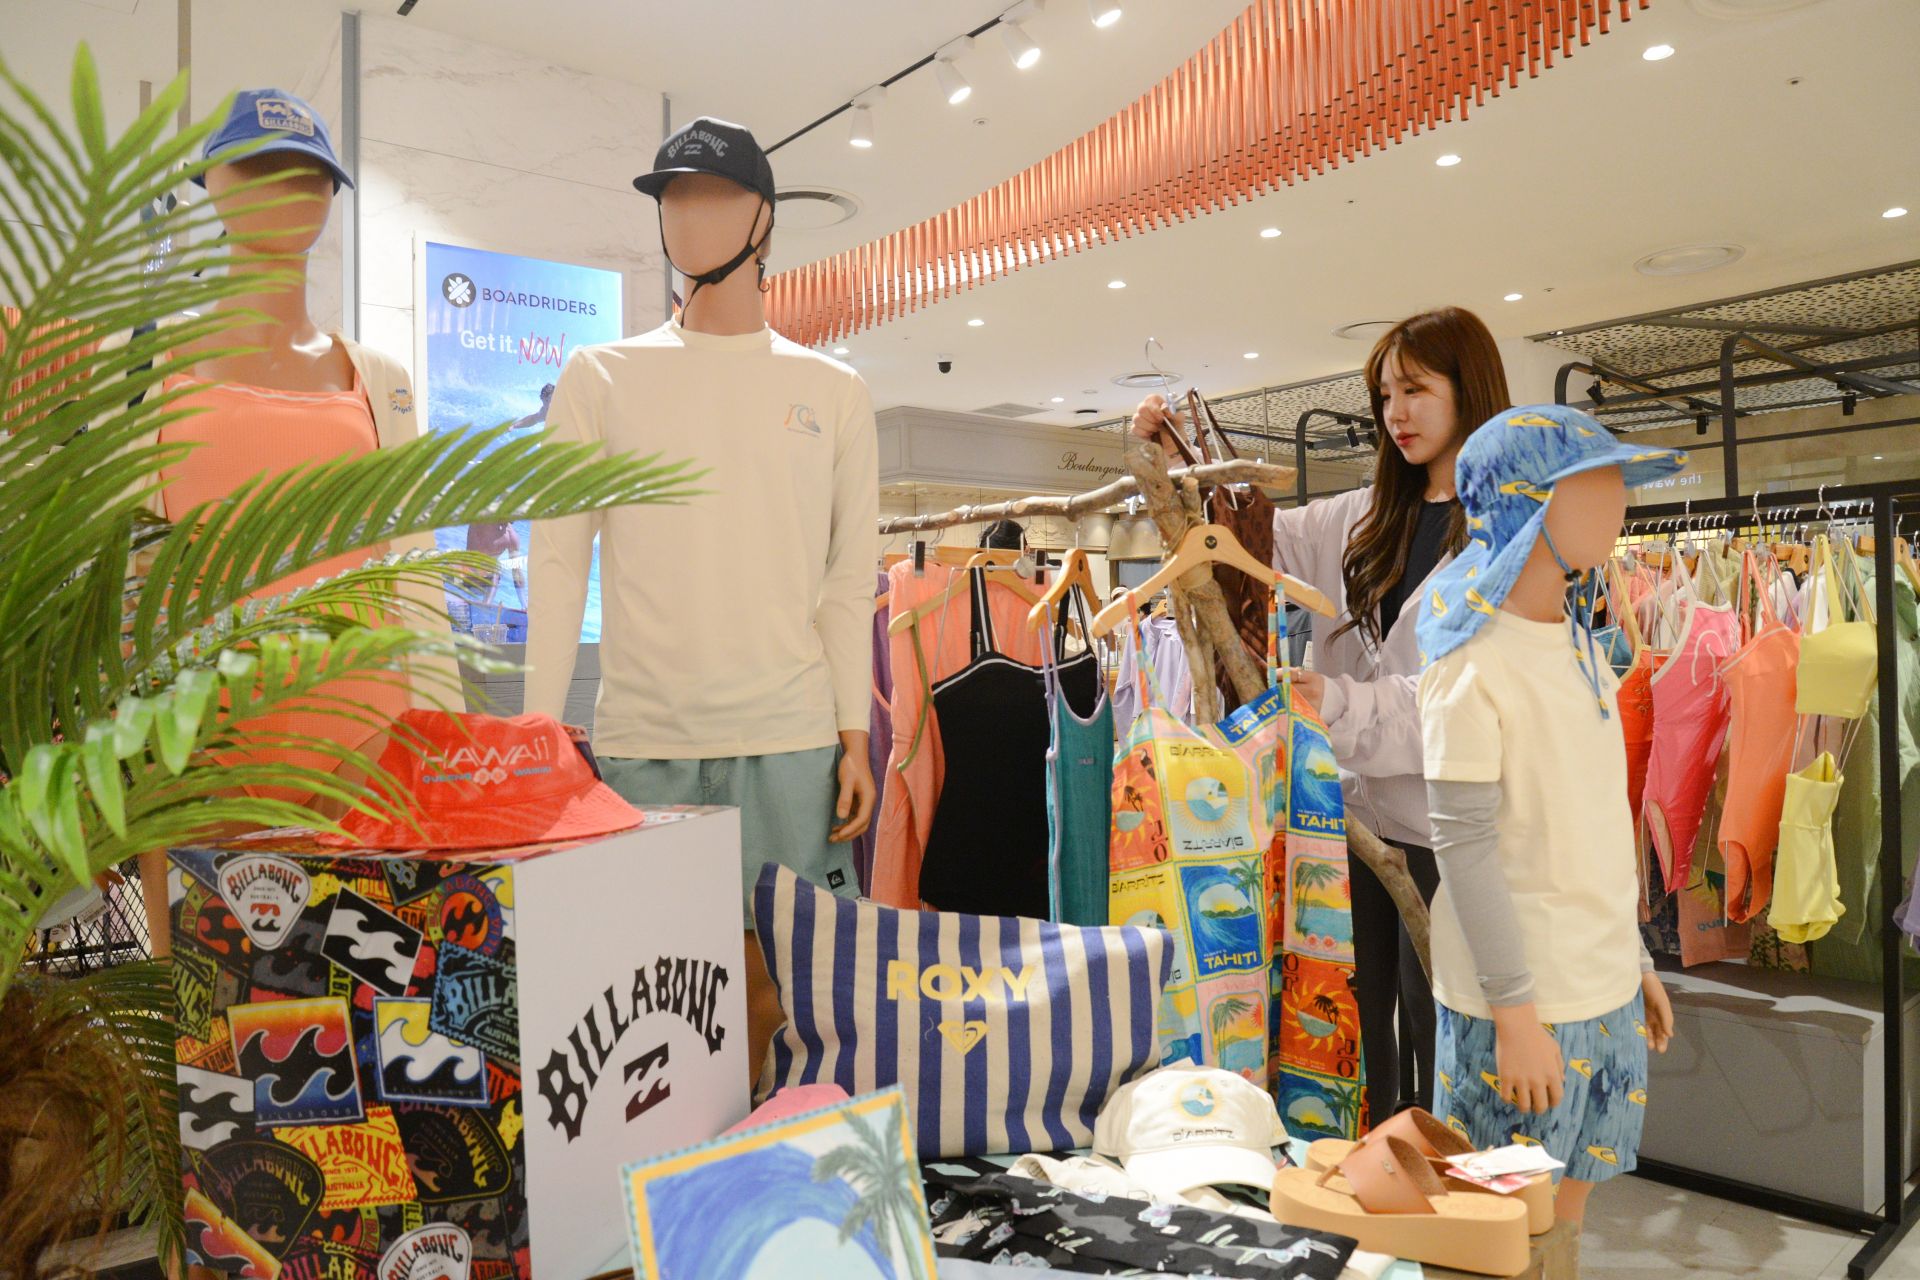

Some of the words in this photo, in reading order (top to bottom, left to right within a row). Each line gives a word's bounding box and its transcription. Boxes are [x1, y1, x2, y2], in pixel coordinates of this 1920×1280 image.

[667, 130, 728, 158] BILLABONG
[482, 288, 597, 316] BOARDRIDERS
[460, 330, 495, 352] Get
[518, 331, 565, 368] NOW
[1057, 451, 1125, 480] Boulangerie
[1231, 694, 1279, 736] TAHIT
[1296, 813, 1347, 831] TAHIT
[227, 863, 302, 904] BILLABONG
[1203, 950, 1257, 969] TAHITI
[887, 959, 1037, 1002] ROXY
[537, 955, 729, 1145] BILLABONG
